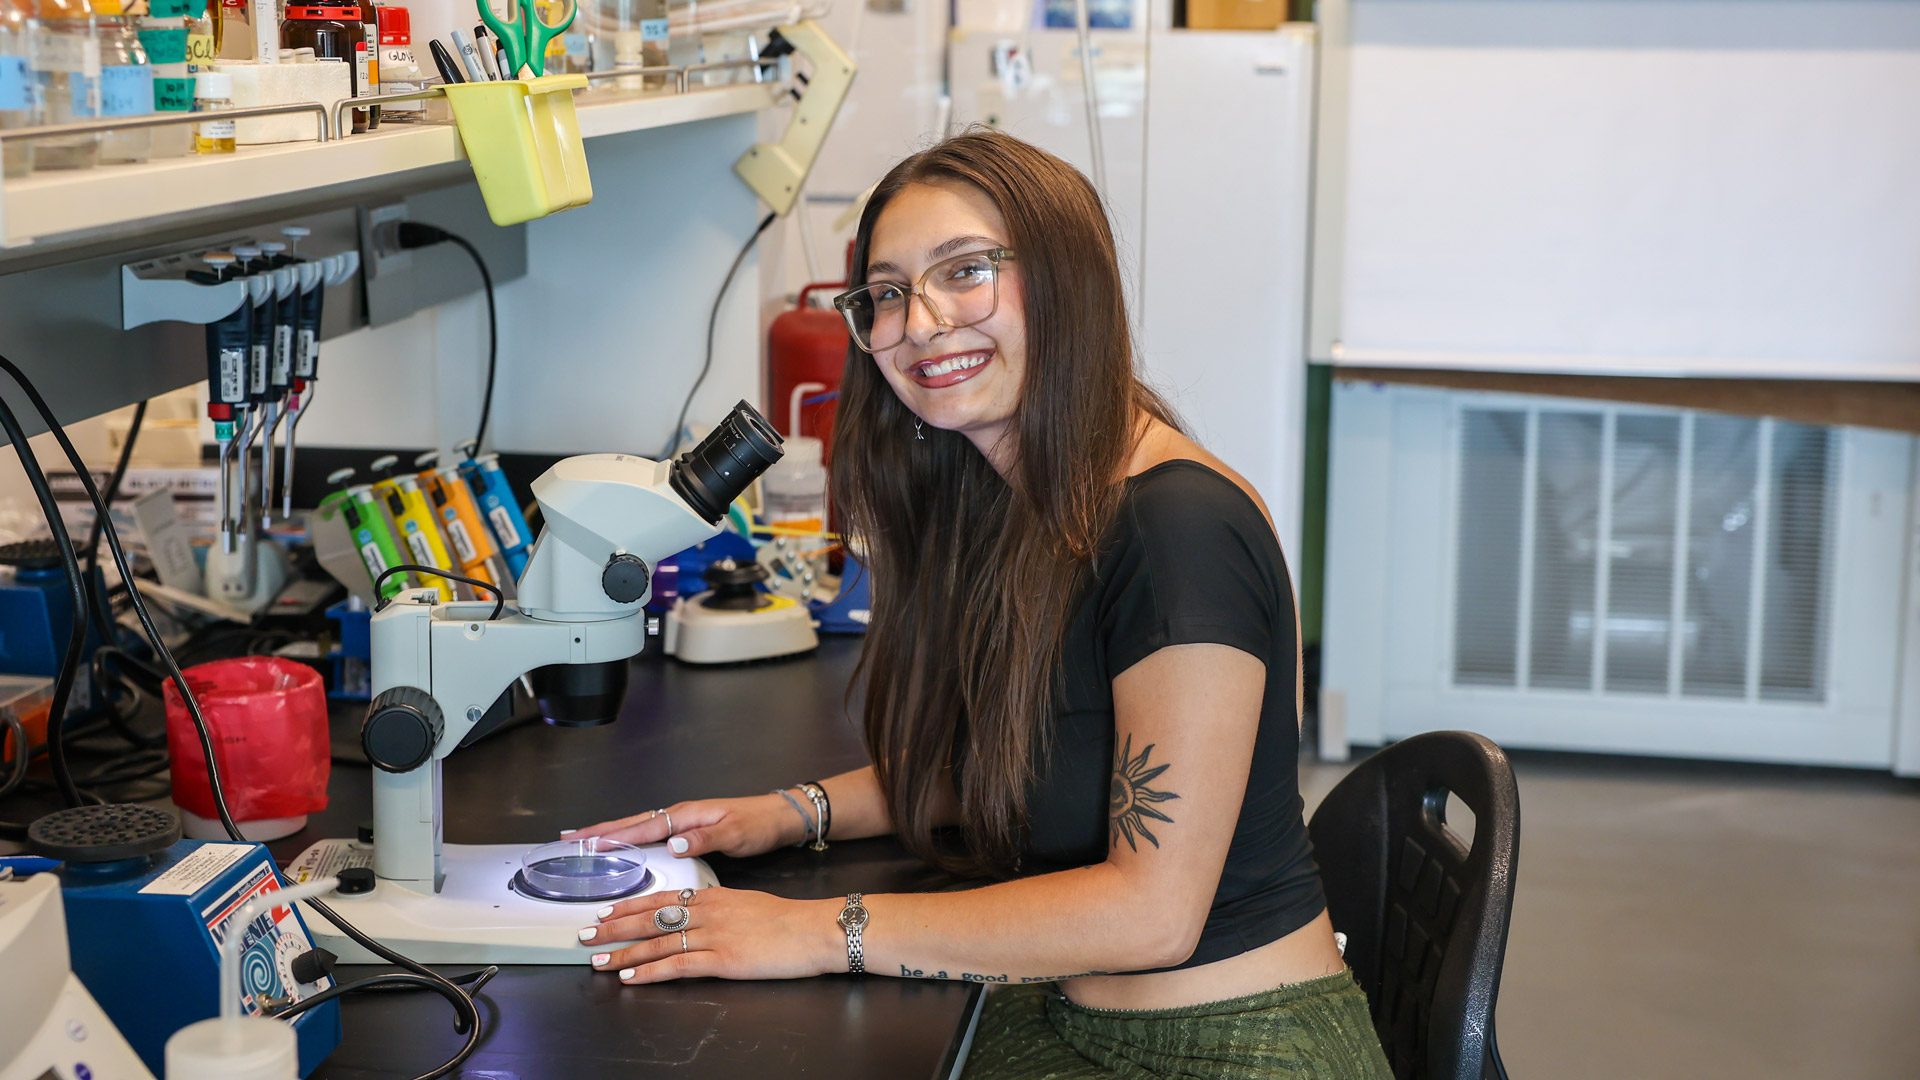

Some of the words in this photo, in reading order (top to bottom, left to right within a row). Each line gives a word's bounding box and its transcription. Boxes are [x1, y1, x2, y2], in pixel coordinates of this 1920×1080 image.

[900, 964, 924, 978] be
[937, 970, 949, 979] a
[961, 972, 1009, 983] good
